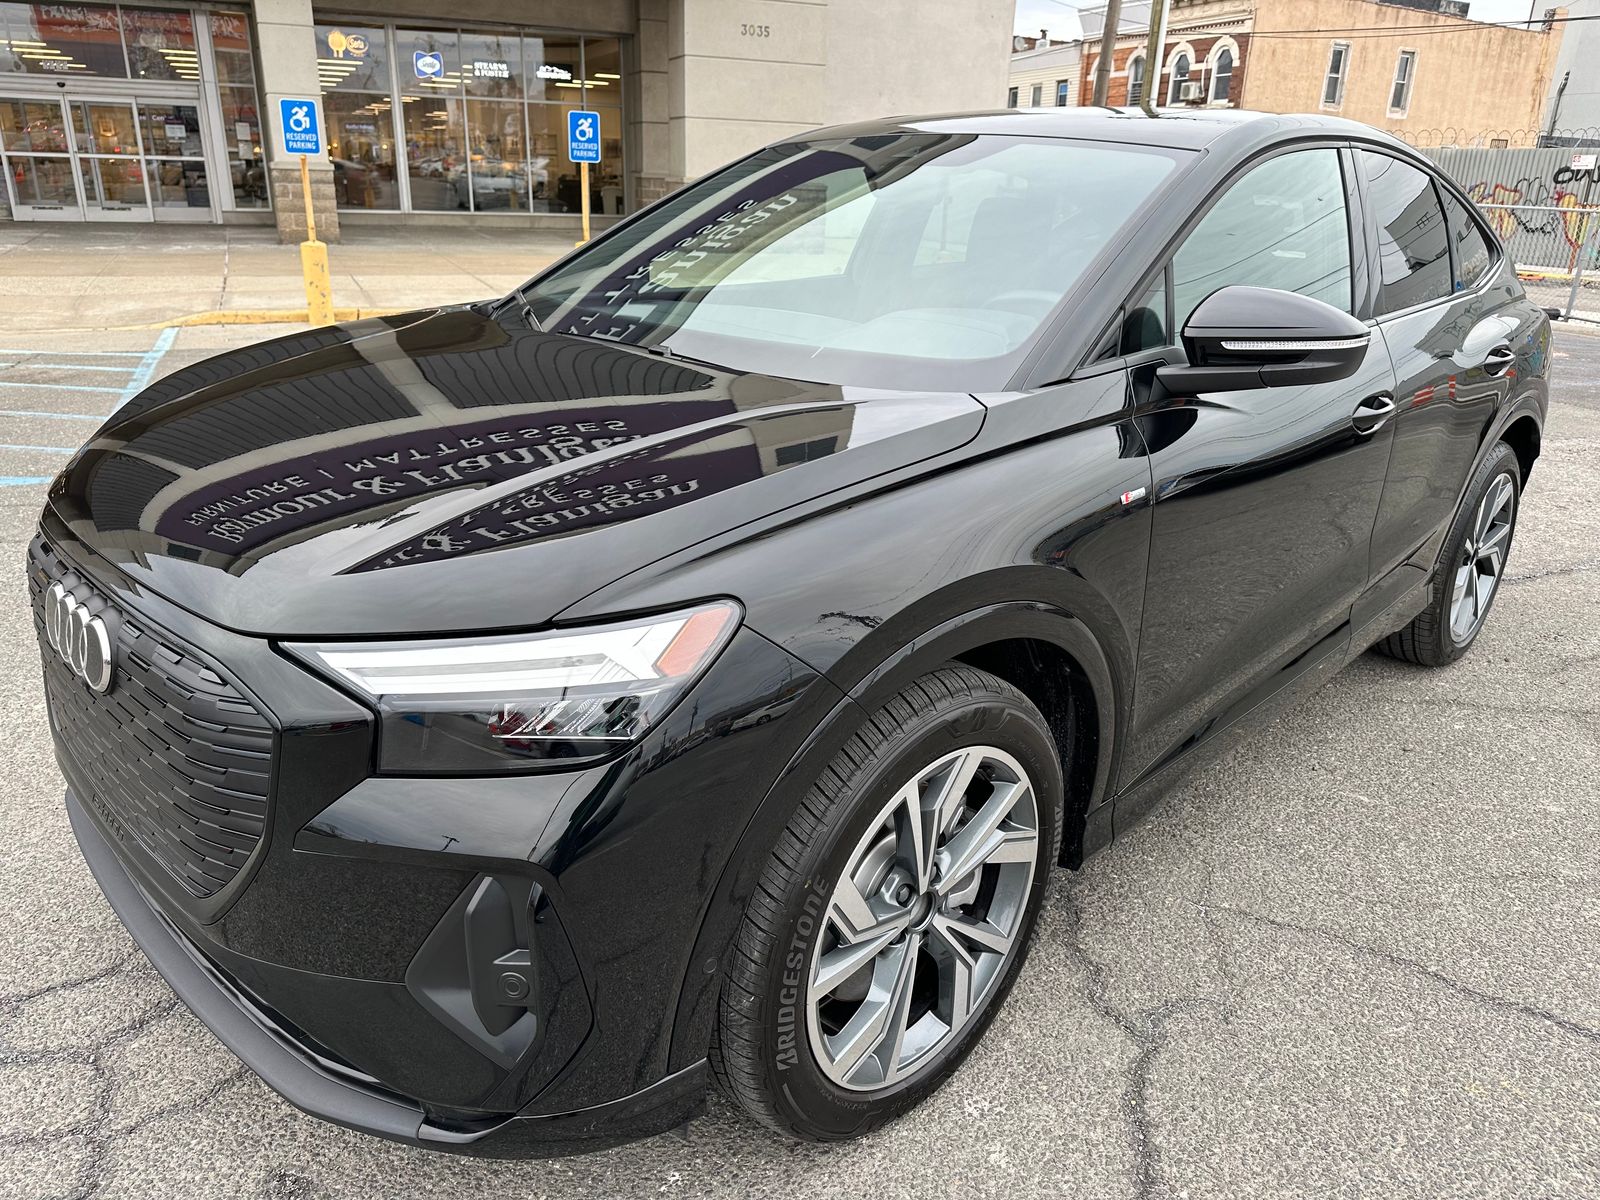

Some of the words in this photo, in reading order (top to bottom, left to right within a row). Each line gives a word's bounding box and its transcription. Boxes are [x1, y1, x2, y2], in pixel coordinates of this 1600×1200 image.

[740, 24, 770, 38] 3035
[286, 132, 316, 142] RESERVED
[288, 141, 316, 150] PARKING
[572, 142, 597, 150] RESERVED
[573, 149, 597, 158] PARKING
[776, 874, 829, 1071] BRIDGESTONE
